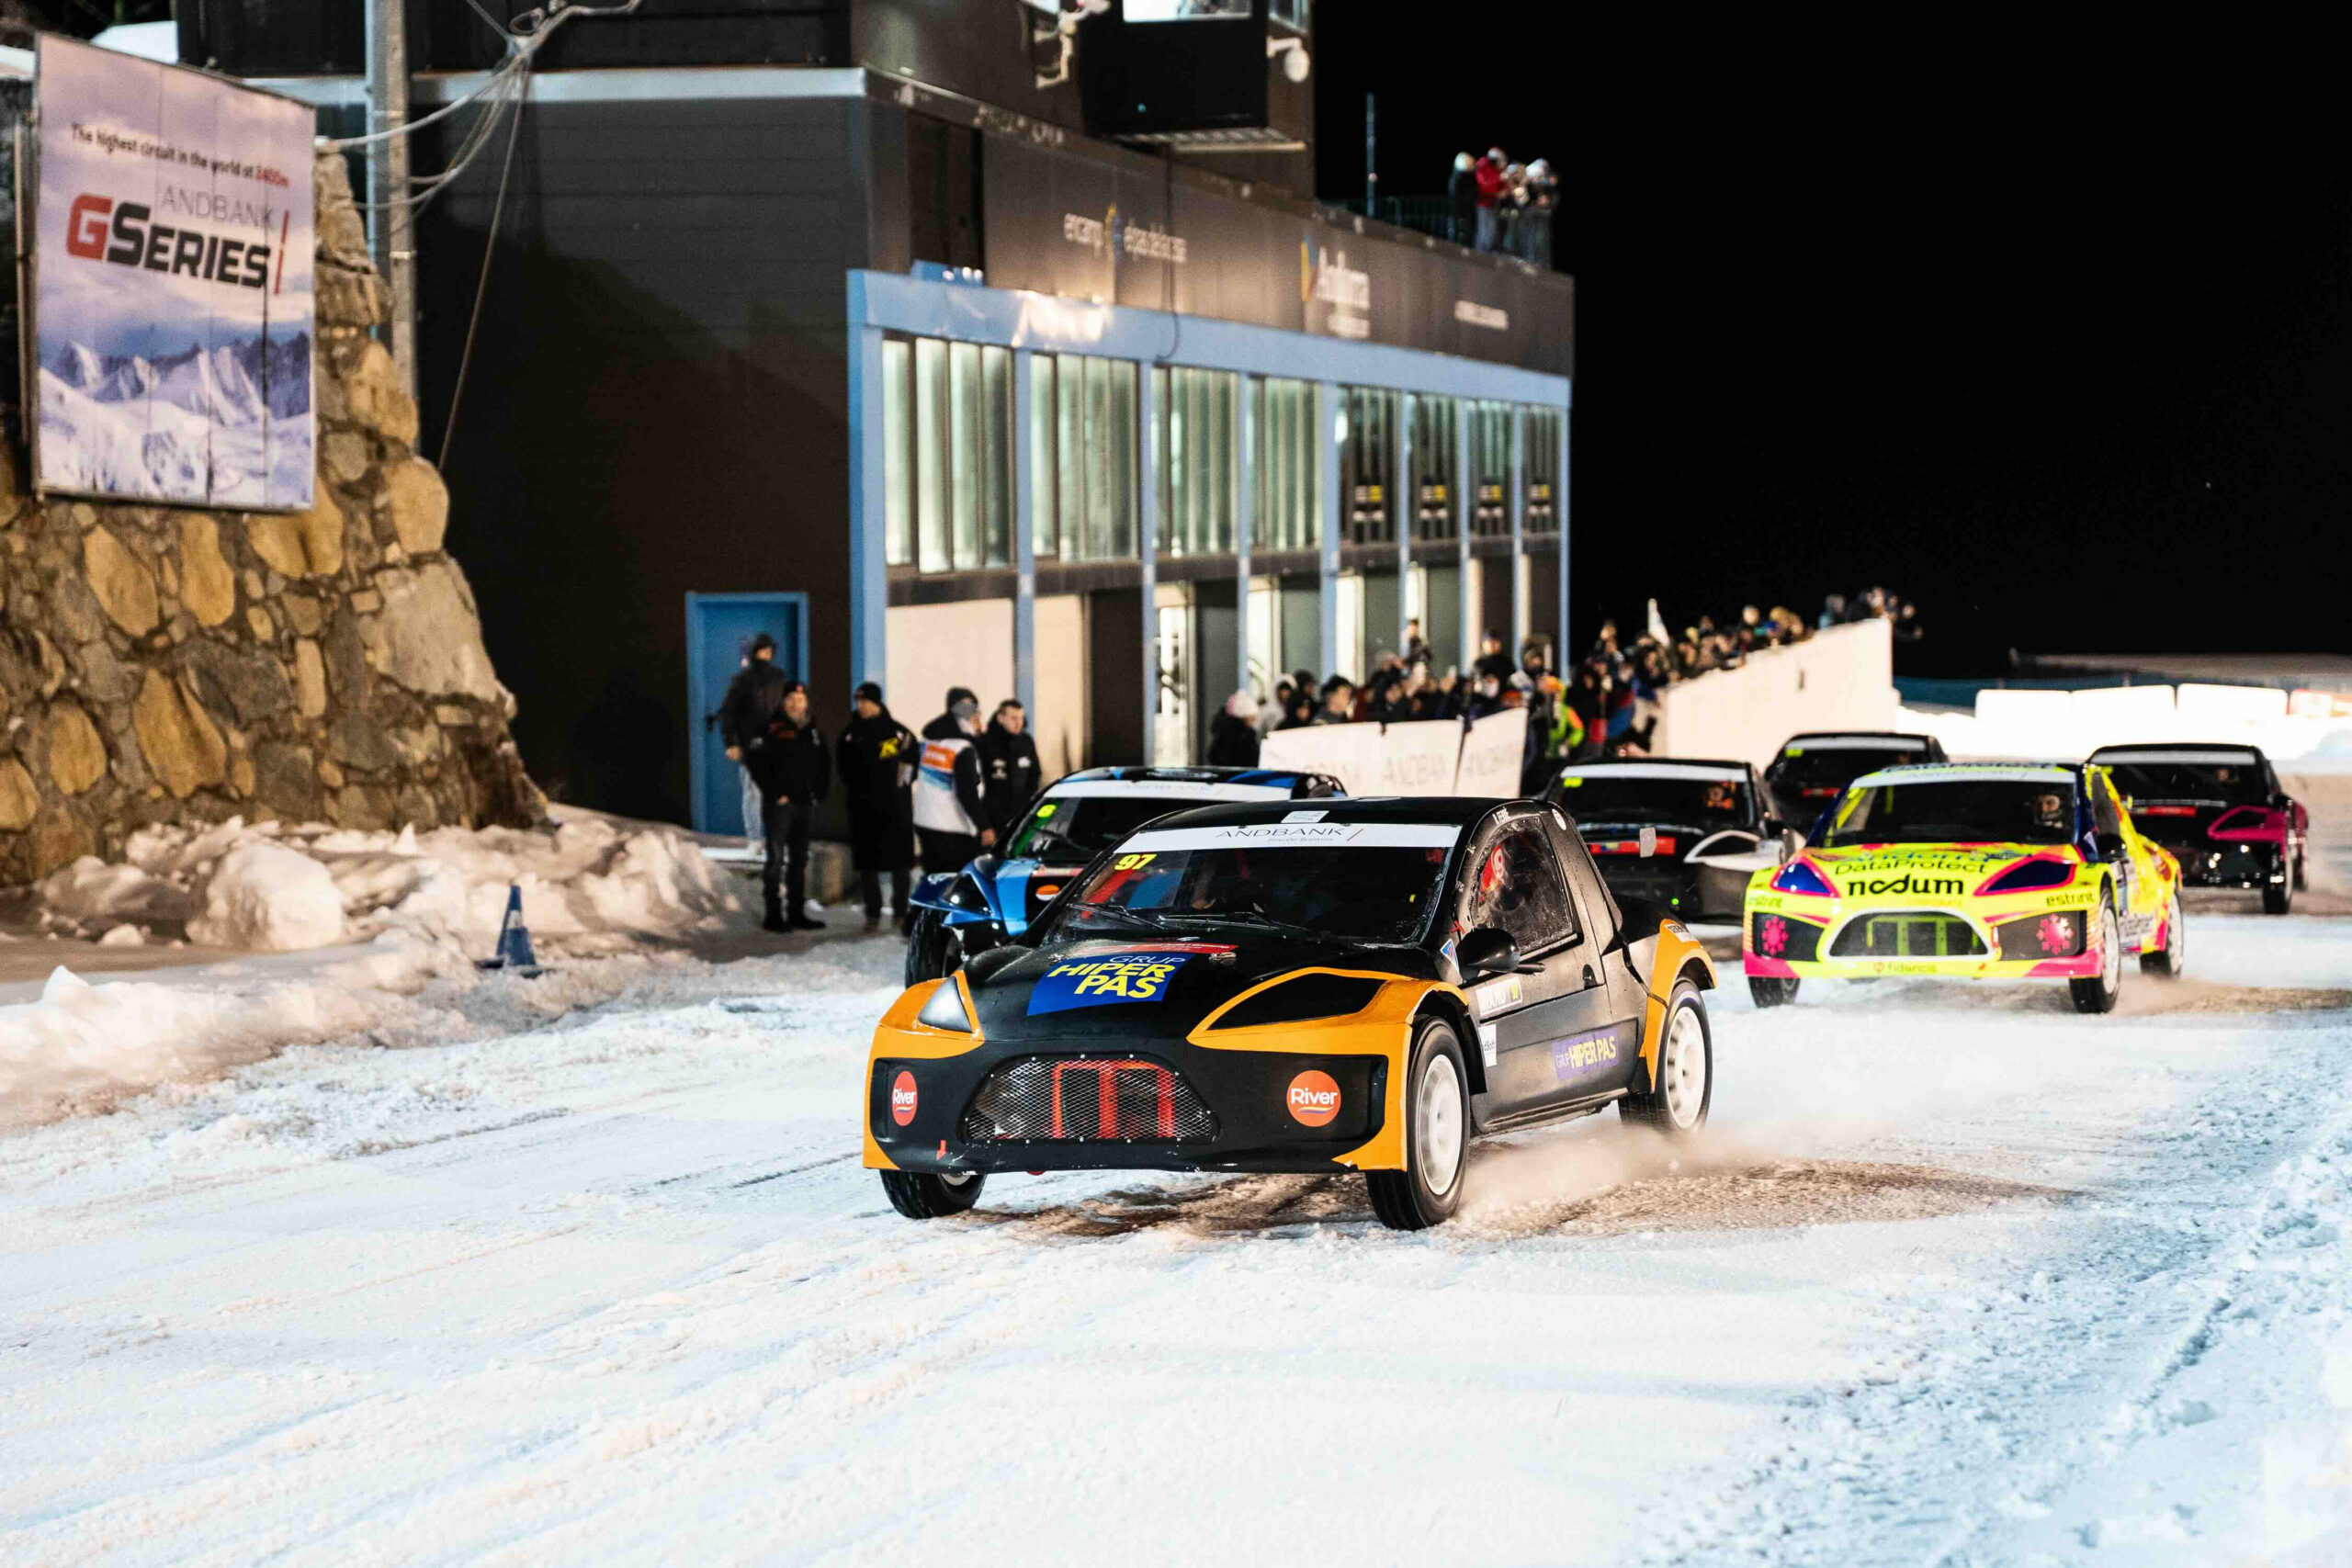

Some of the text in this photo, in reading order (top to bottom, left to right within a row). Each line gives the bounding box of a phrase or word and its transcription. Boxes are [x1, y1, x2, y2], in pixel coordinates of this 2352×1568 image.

[73, 122, 93, 143] The
[96, 130, 137, 154] highest
[140, 142, 175, 163] circuit
[177, 151, 187, 164] in
[190, 152, 208, 168] the
[210, 159, 240, 176] world
[161, 185, 274, 229] ANDBANK
[1216, 828, 1345, 839] ANDBANK
[1114, 853, 1158, 870] 97
[1835, 858, 1987, 874] DataProtect
[1848, 874, 1964, 896] nodum
[1109, 955, 1186, 964] GRUP
[1047, 963, 1176, 978] HIPER
[1074, 976, 1165, 998] PAS
[1568, 1041, 1598, 1068] HIPER
[1596, 1035, 1617, 1062] PAS
[893, 1089, 917, 1104] River
[1291, 1088, 1339, 1105] River
